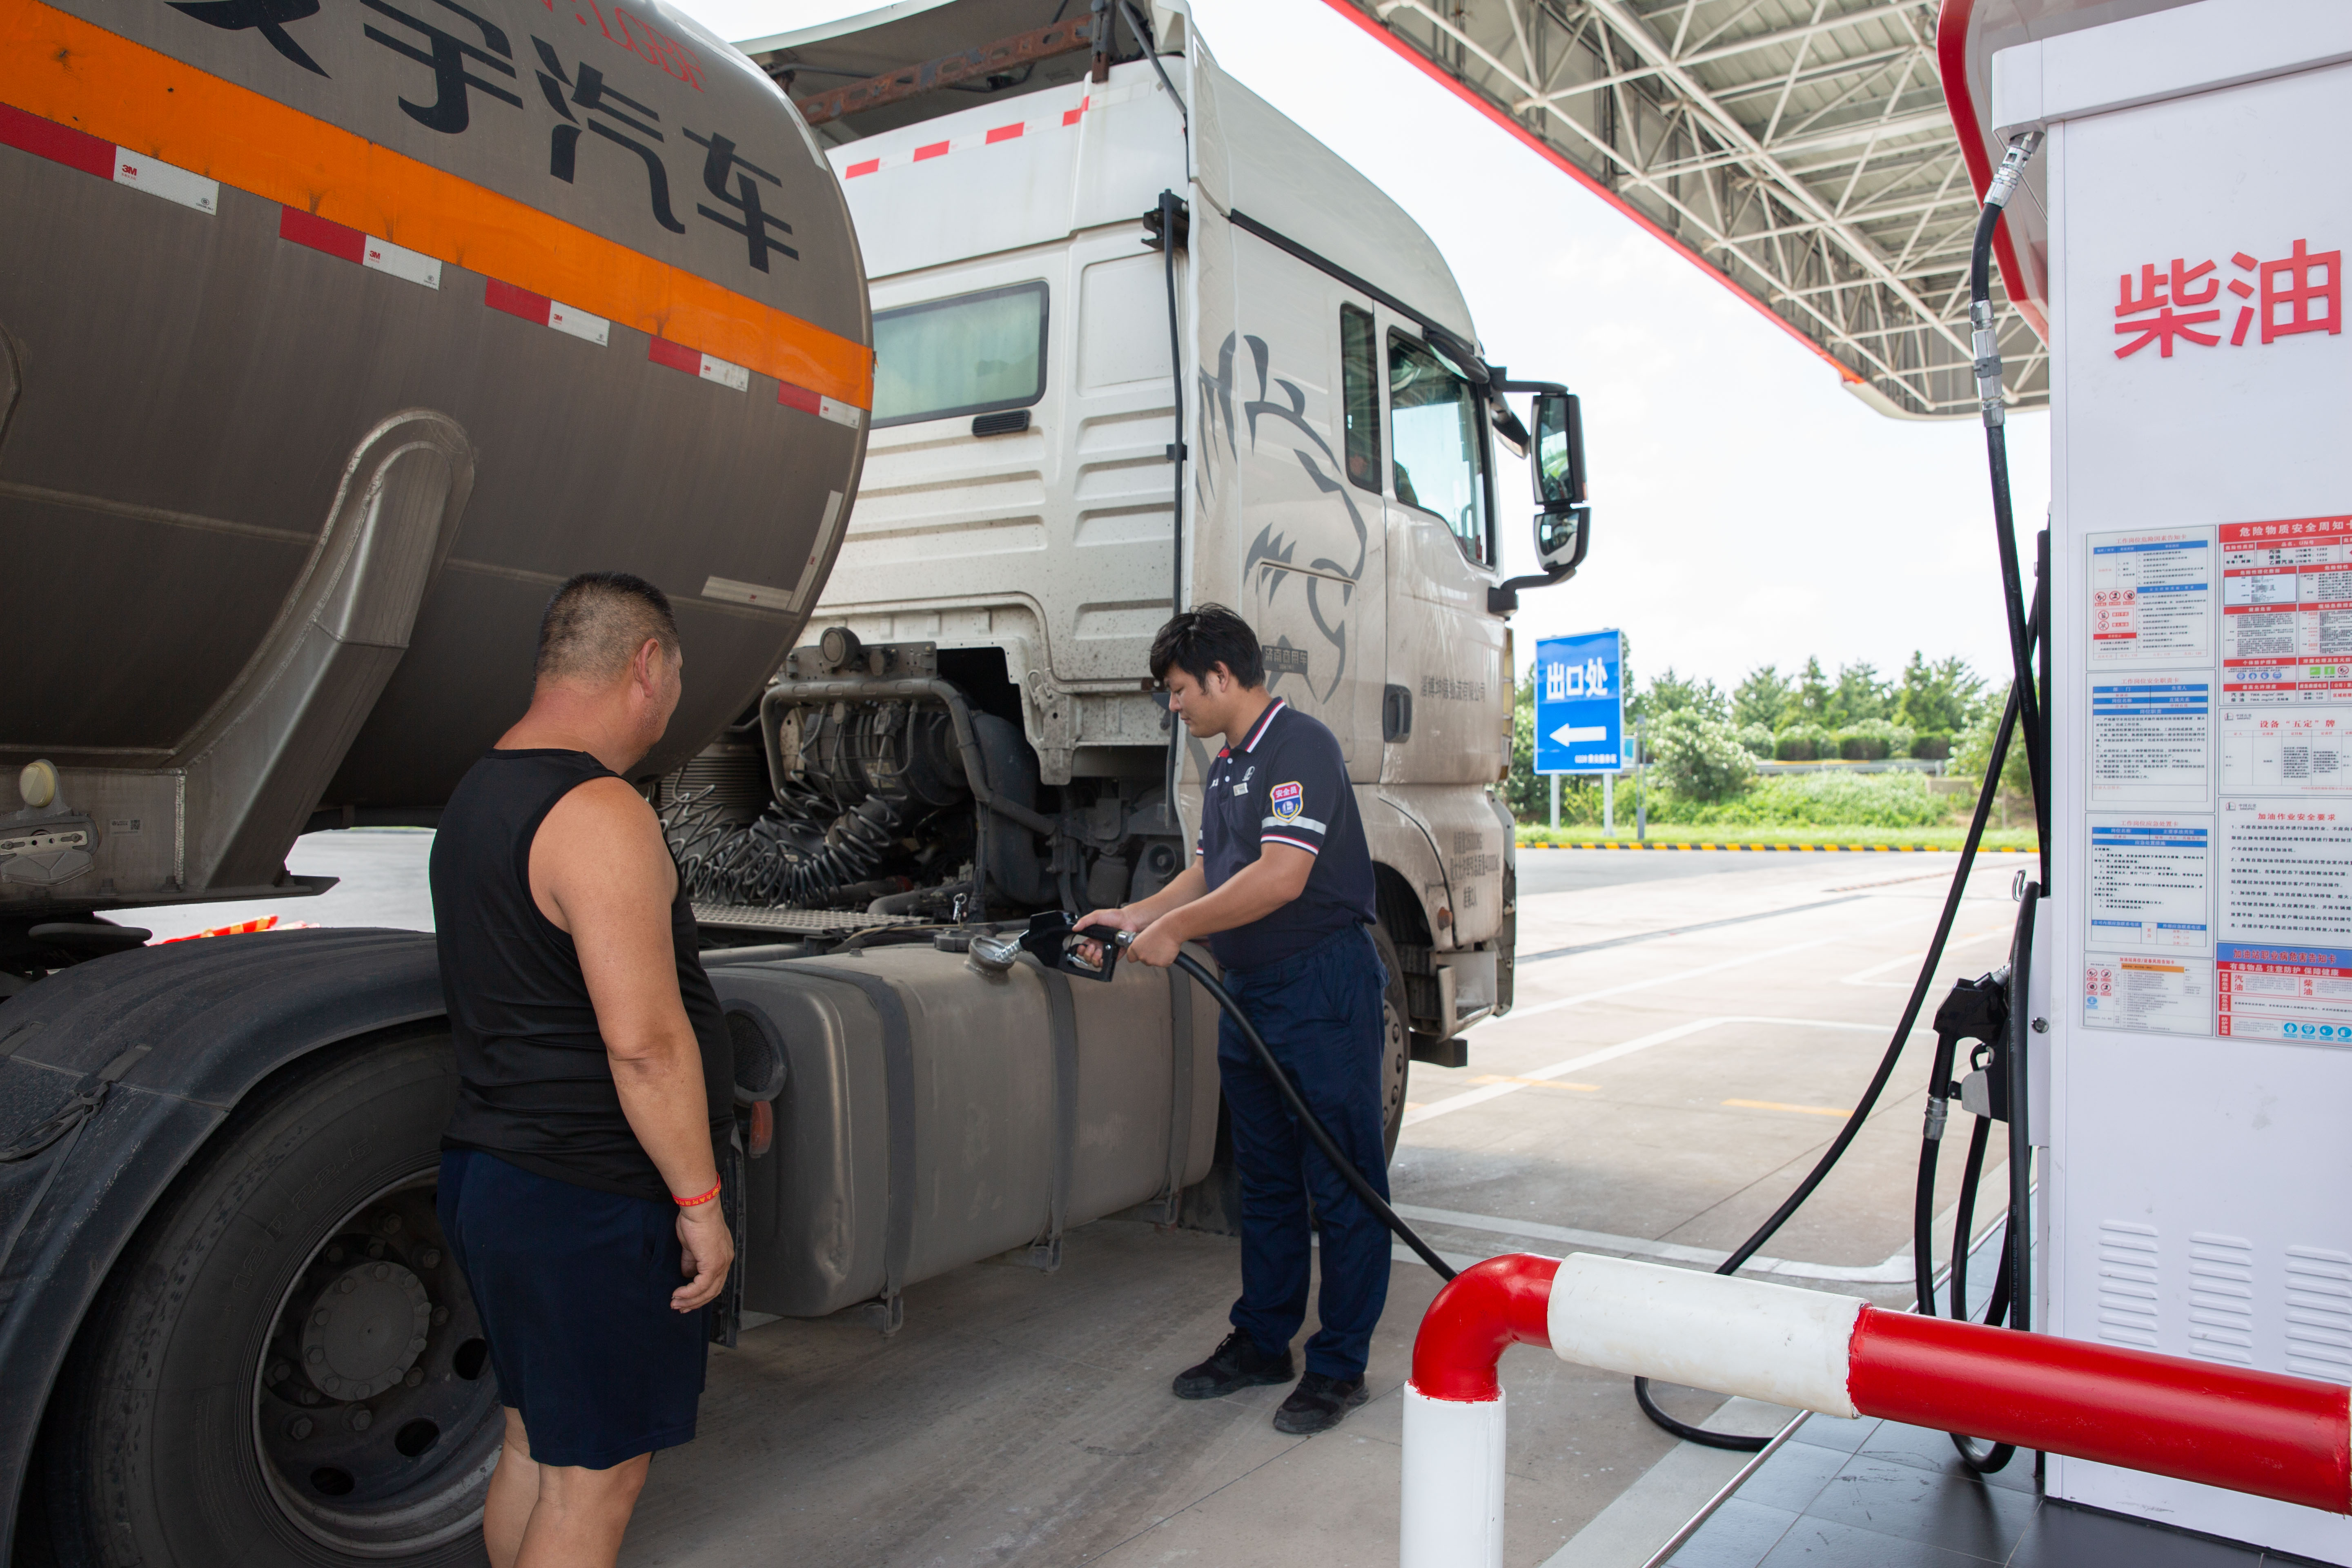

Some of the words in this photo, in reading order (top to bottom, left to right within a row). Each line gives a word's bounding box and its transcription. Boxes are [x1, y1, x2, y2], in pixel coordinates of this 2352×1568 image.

[159, 0, 800, 273] 宇汽车
[122, 164, 137, 176] 3M
[370, 250, 381, 260] 3M
[2114, 238, 2342, 359] 柴油
[1546, 656, 1608, 700] 出口处
[1276, 786, 1298, 797] 安全员
[2258, 813, 2336, 821] 加油作业安全要求
[2233, 949, 2337, 964] 加油站职业病危害告知卡
[2230, 963, 2263, 971] 有毒物品
[2267, 965, 2301, 973] 注意防护
[2304, 967, 2339, 976] 保障健康
[2234, 975, 2243, 991] 汽油
[2303, 979, 2313, 996] 柴油
